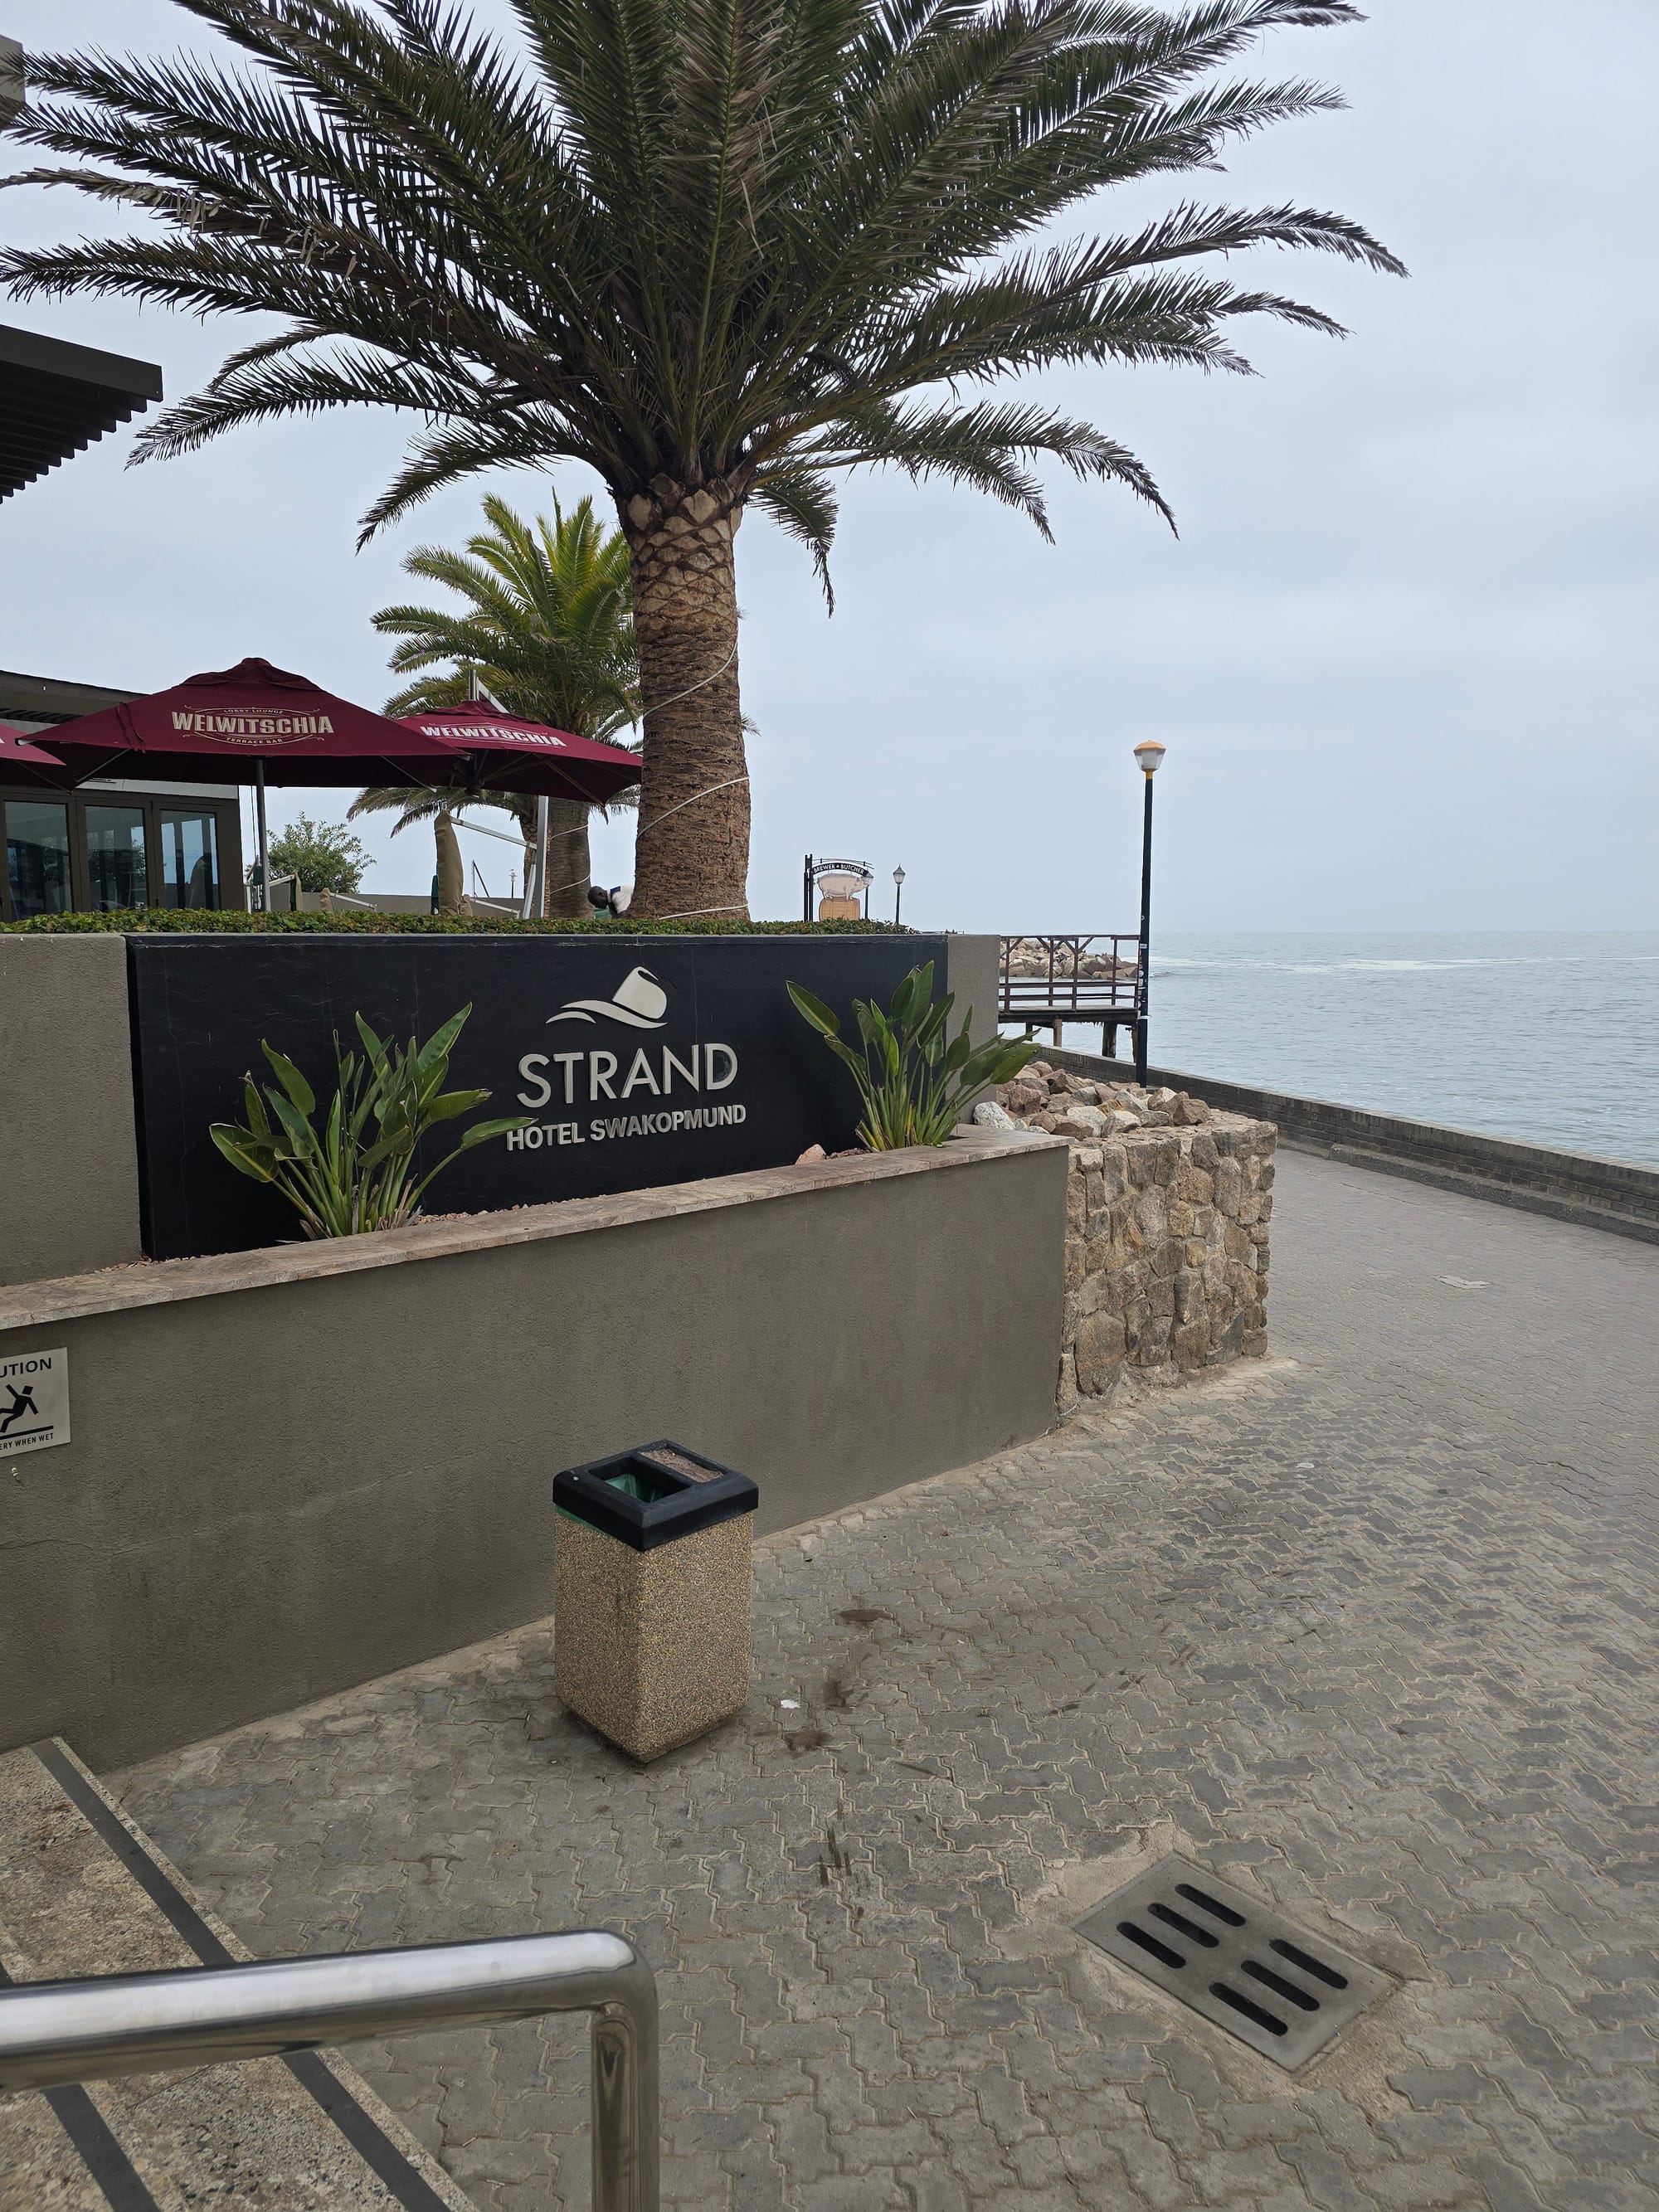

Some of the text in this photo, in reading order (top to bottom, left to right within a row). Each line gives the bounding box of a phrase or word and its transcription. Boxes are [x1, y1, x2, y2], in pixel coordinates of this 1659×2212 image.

[172, 711, 334, 734] WELWITSCHIA
[420, 726, 567, 746] WELWITSCHIA
[814, 863, 835, 873] BREWER
[840, 863, 864, 875] BUTCHER
[516, 1043, 738, 1108] STRAND
[507, 1104, 747, 1151] HOTEL SWAKOPMUND
[15, 1437, 36, 1447] WHEN
[39, 1432, 54, 1441] WET
